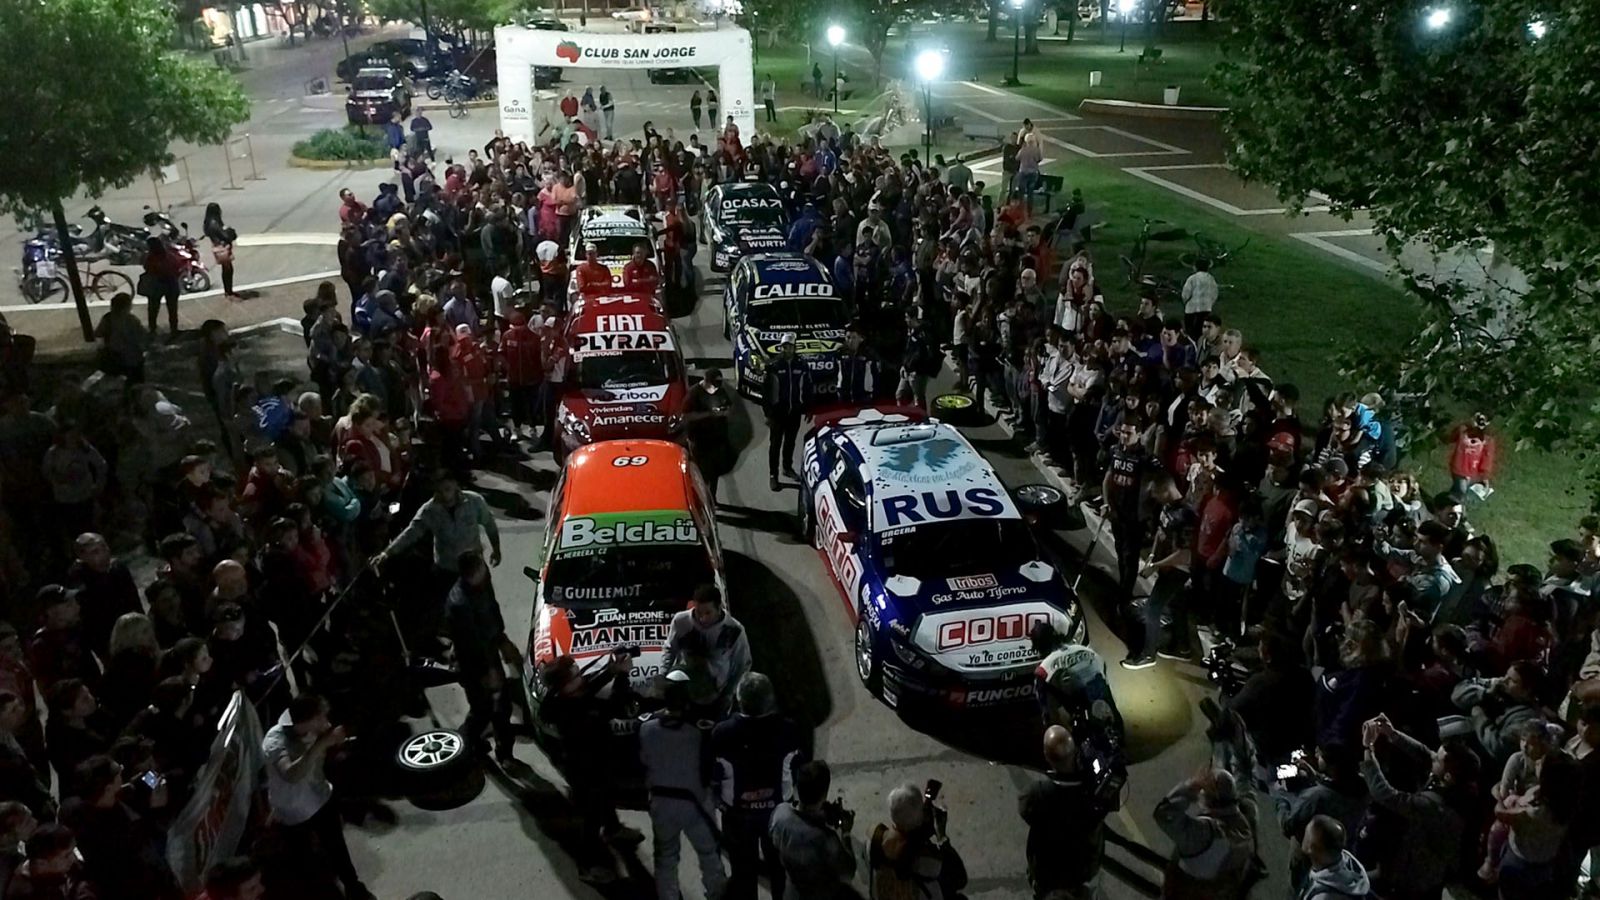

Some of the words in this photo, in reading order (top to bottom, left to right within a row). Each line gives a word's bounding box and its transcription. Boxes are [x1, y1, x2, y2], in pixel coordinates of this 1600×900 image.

[584, 47, 620, 59] CLUB
[623, 48, 650, 59] SAN
[652, 46, 697, 58] JORGE
[722, 198, 769, 209] OCASA
[754, 283, 834, 299] CALICO
[596, 314, 645, 332] FIAT
[574, 333, 668, 351] PLYRAP
[592, 414, 666, 427] Amanecer
[612, 455, 649, 468] 69
[1113, 459, 1135, 473] RUS
[882, 488, 1004, 528] RUS
[881, 525, 917, 539] URCERA
[564, 550, 595, 560] HERRERA
[956, 575, 994, 590] tribos
[565, 583, 643, 600] GUILLEMOT
[931, 593, 953, 605] Gas
[957, 589, 986, 602] Auto
[599, 612, 626, 624] JUAN
[628, 610, 665, 621] PICONE
[968, 654, 981, 664] Yo
